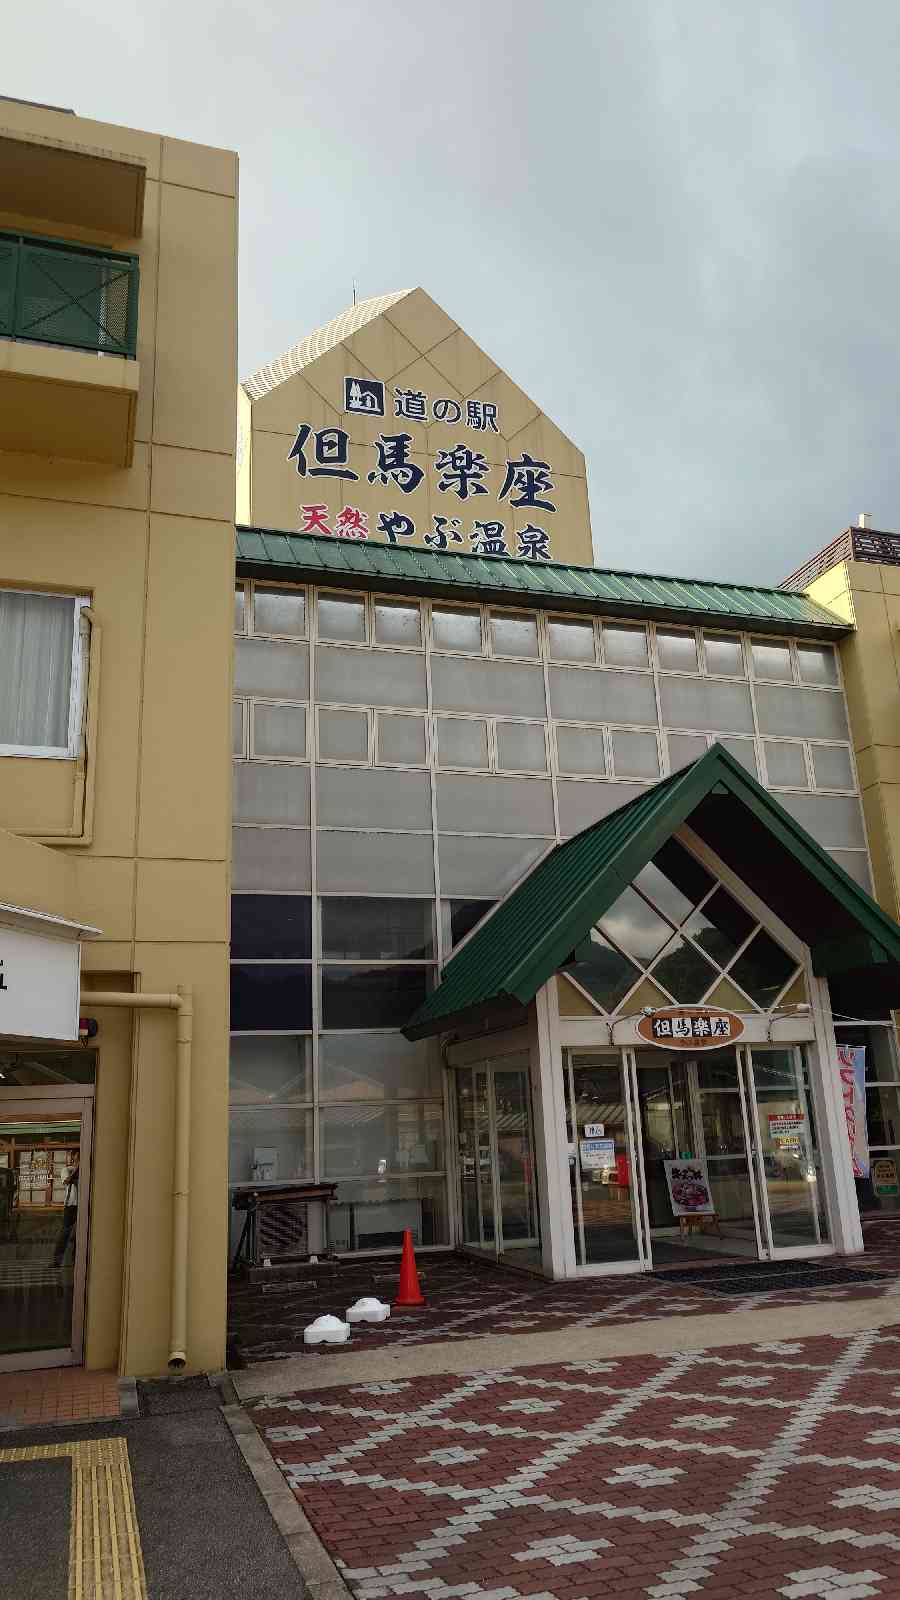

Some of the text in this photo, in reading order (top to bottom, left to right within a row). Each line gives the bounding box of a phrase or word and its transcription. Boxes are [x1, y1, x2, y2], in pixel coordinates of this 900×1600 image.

[394, 388, 500, 433] 道の駅
[287, 423, 557, 513] 但馬楽座
[653, 1017, 730, 1037] 但馬楽座
